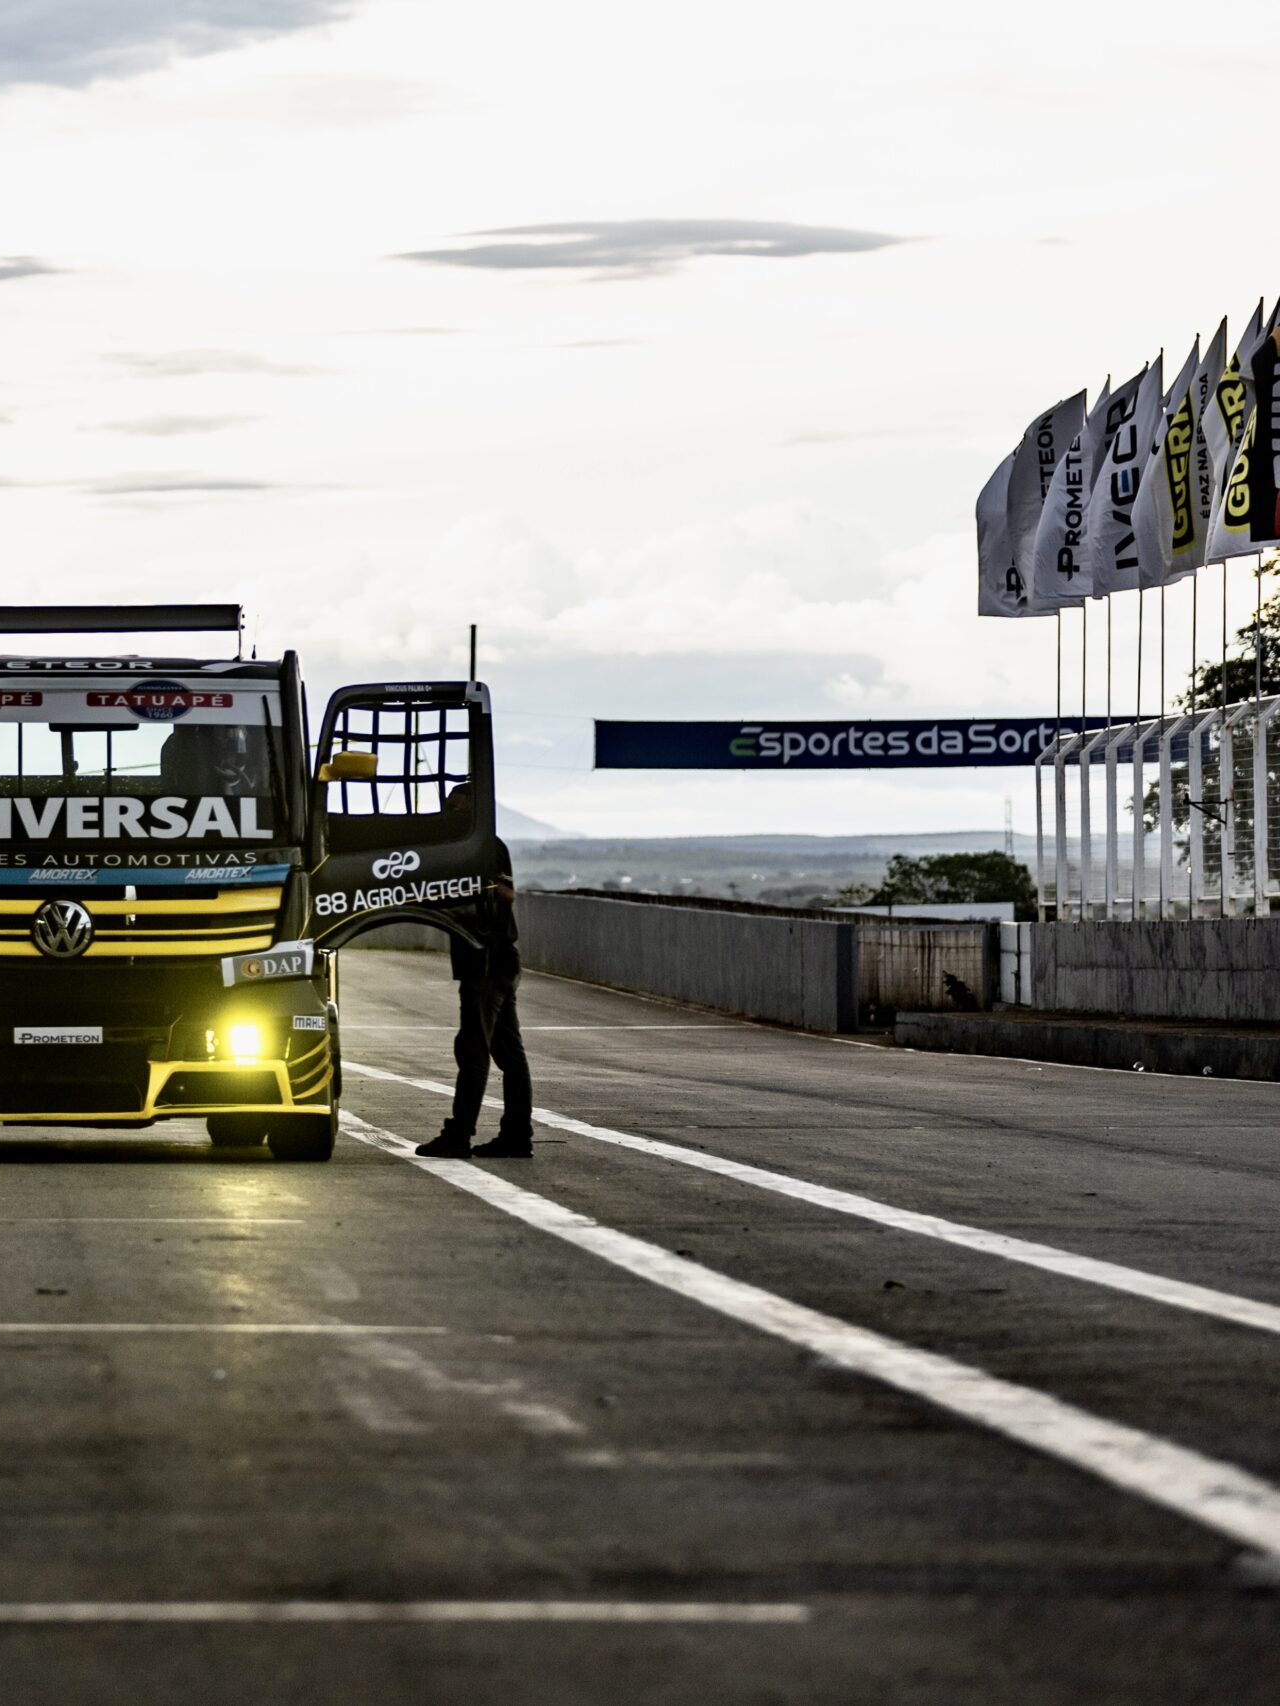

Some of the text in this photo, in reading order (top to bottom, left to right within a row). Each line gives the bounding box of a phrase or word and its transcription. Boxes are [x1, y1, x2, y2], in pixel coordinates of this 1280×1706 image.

[1199, 474, 1210, 506] PAZ
[97, 693, 225, 706] TATUAPÉ
[728, 725, 911, 765] Esportes
[915, 724, 964, 757] da
[42, 851, 258, 866] AUTOMOTIVAS
[30, 867, 100, 880] AMORTEX
[184, 866, 254, 880] AMORTEX
[314, 891, 348, 916] 88
[263, 956, 302, 974] DAP
[294, 1016, 326, 1029] MAHLE
[18, 1032, 100, 1044] PROMETEON
